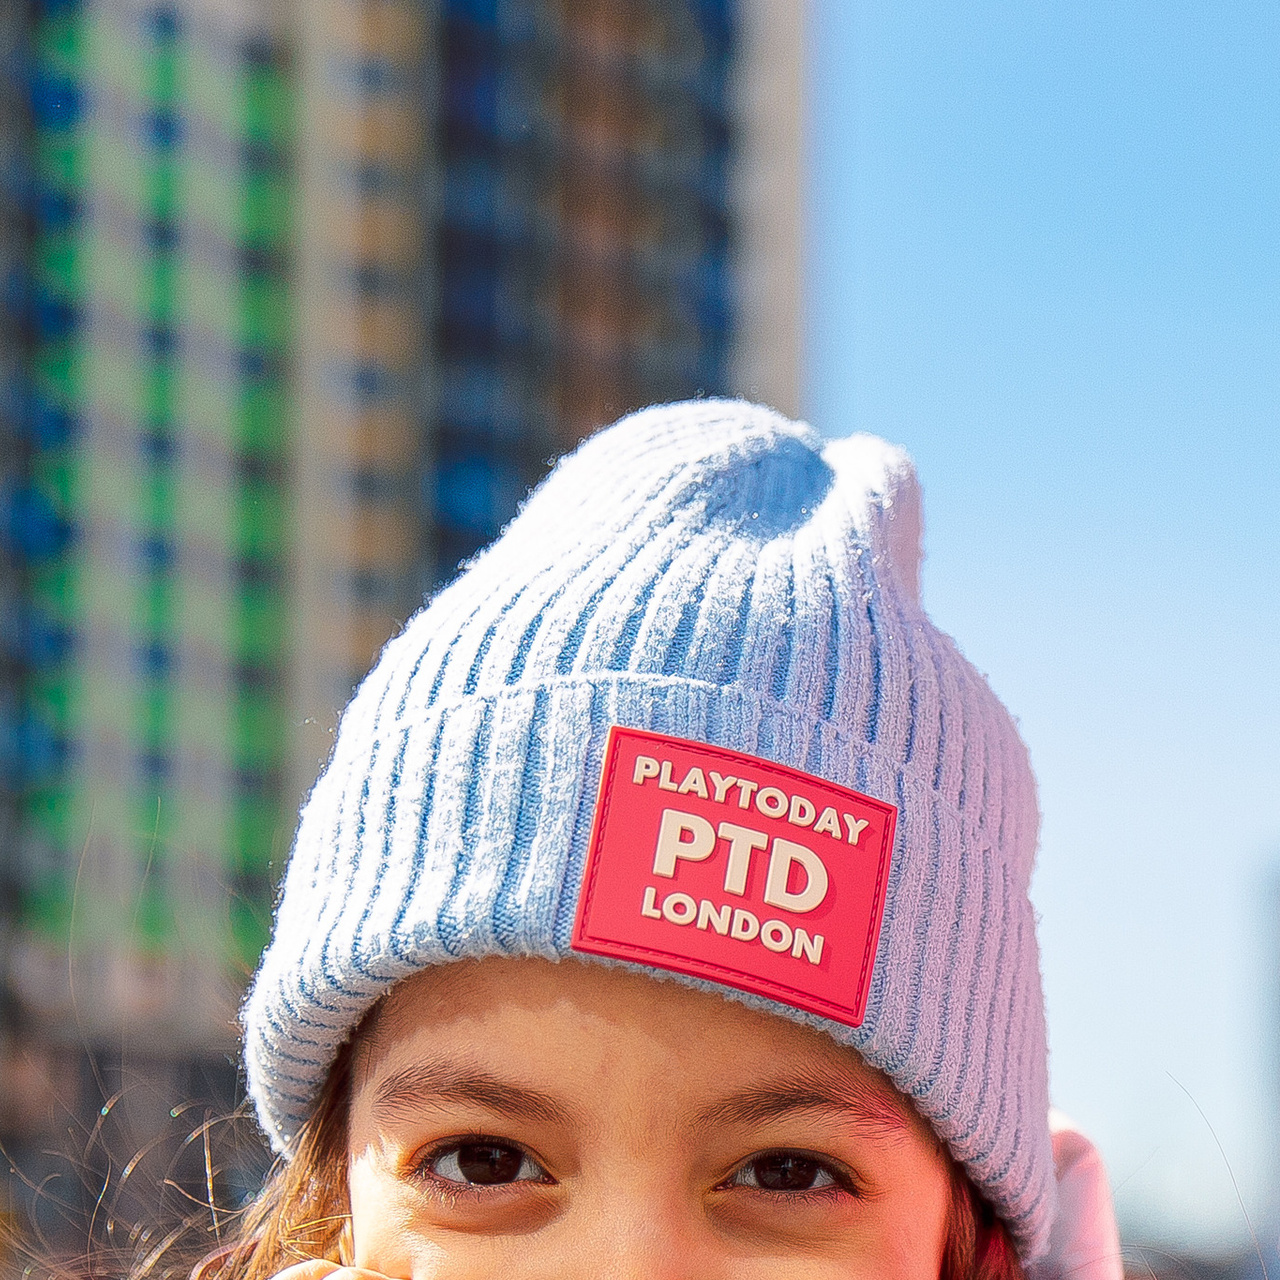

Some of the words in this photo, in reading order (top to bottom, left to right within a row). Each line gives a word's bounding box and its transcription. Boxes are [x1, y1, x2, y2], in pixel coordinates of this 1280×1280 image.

[632, 755, 869, 846] PLAYTODAY
[652, 808, 829, 914] PTD
[641, 887, 825, 966] LONDON
